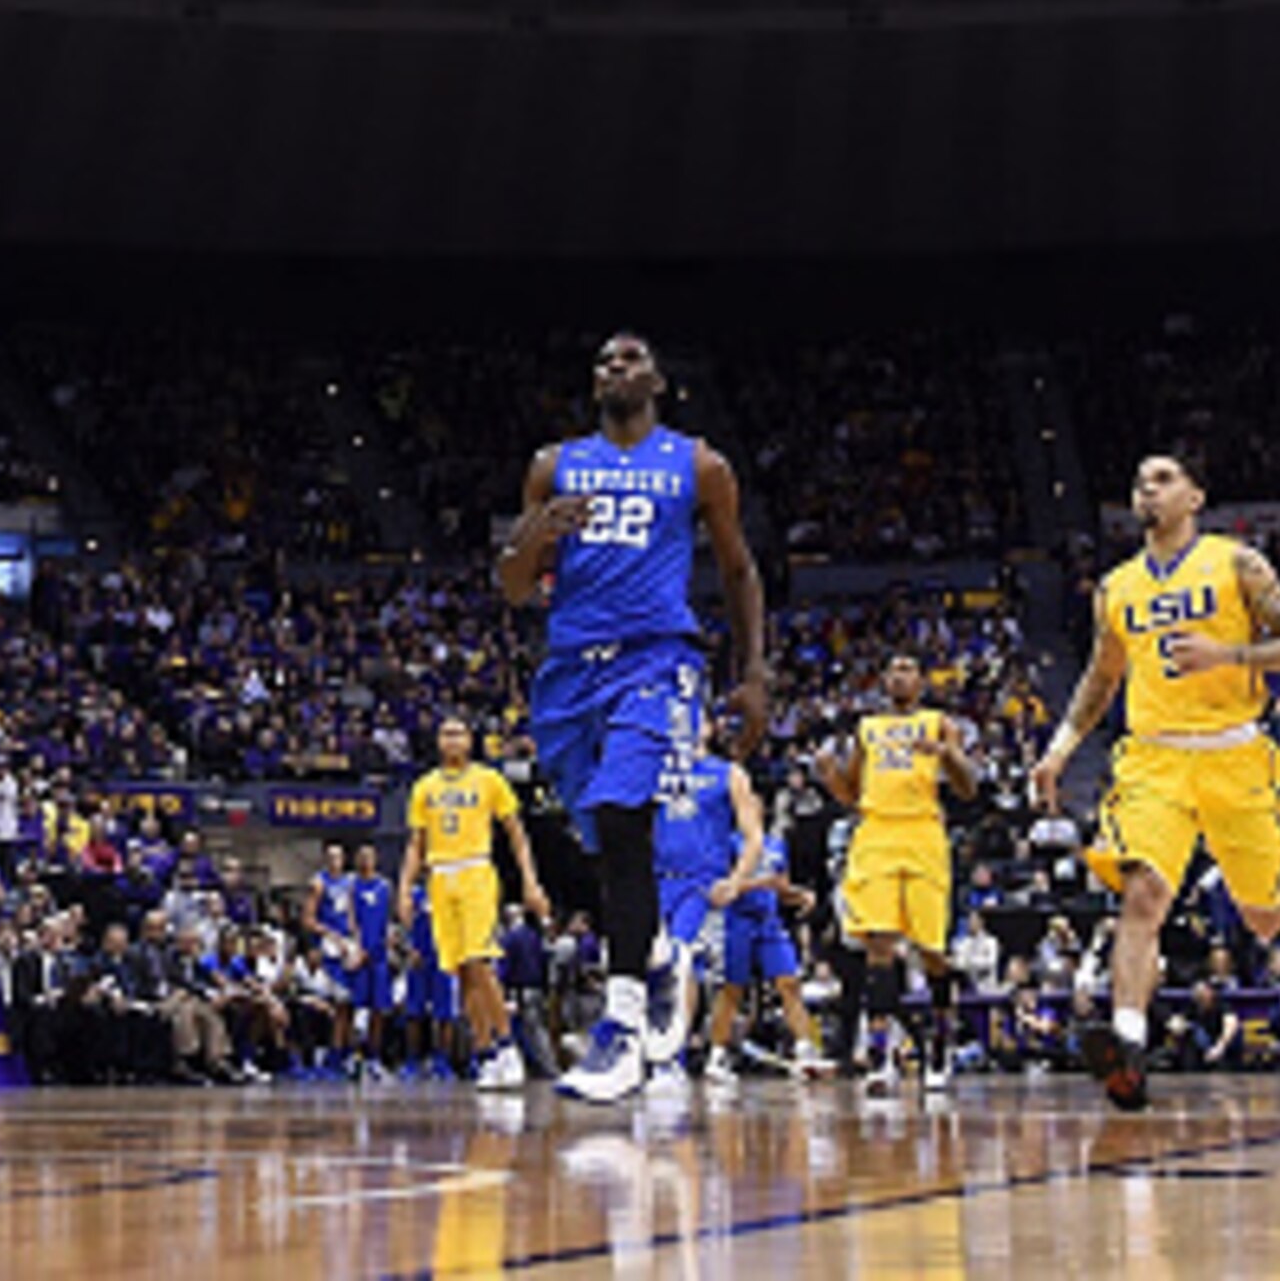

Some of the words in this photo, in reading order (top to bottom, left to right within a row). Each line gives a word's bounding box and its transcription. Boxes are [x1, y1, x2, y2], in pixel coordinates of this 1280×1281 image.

[580, 495, 655, 549] 22
[1125, 585, 1217, 633] LSU
[274, 787, 377, 818] TIGERS
